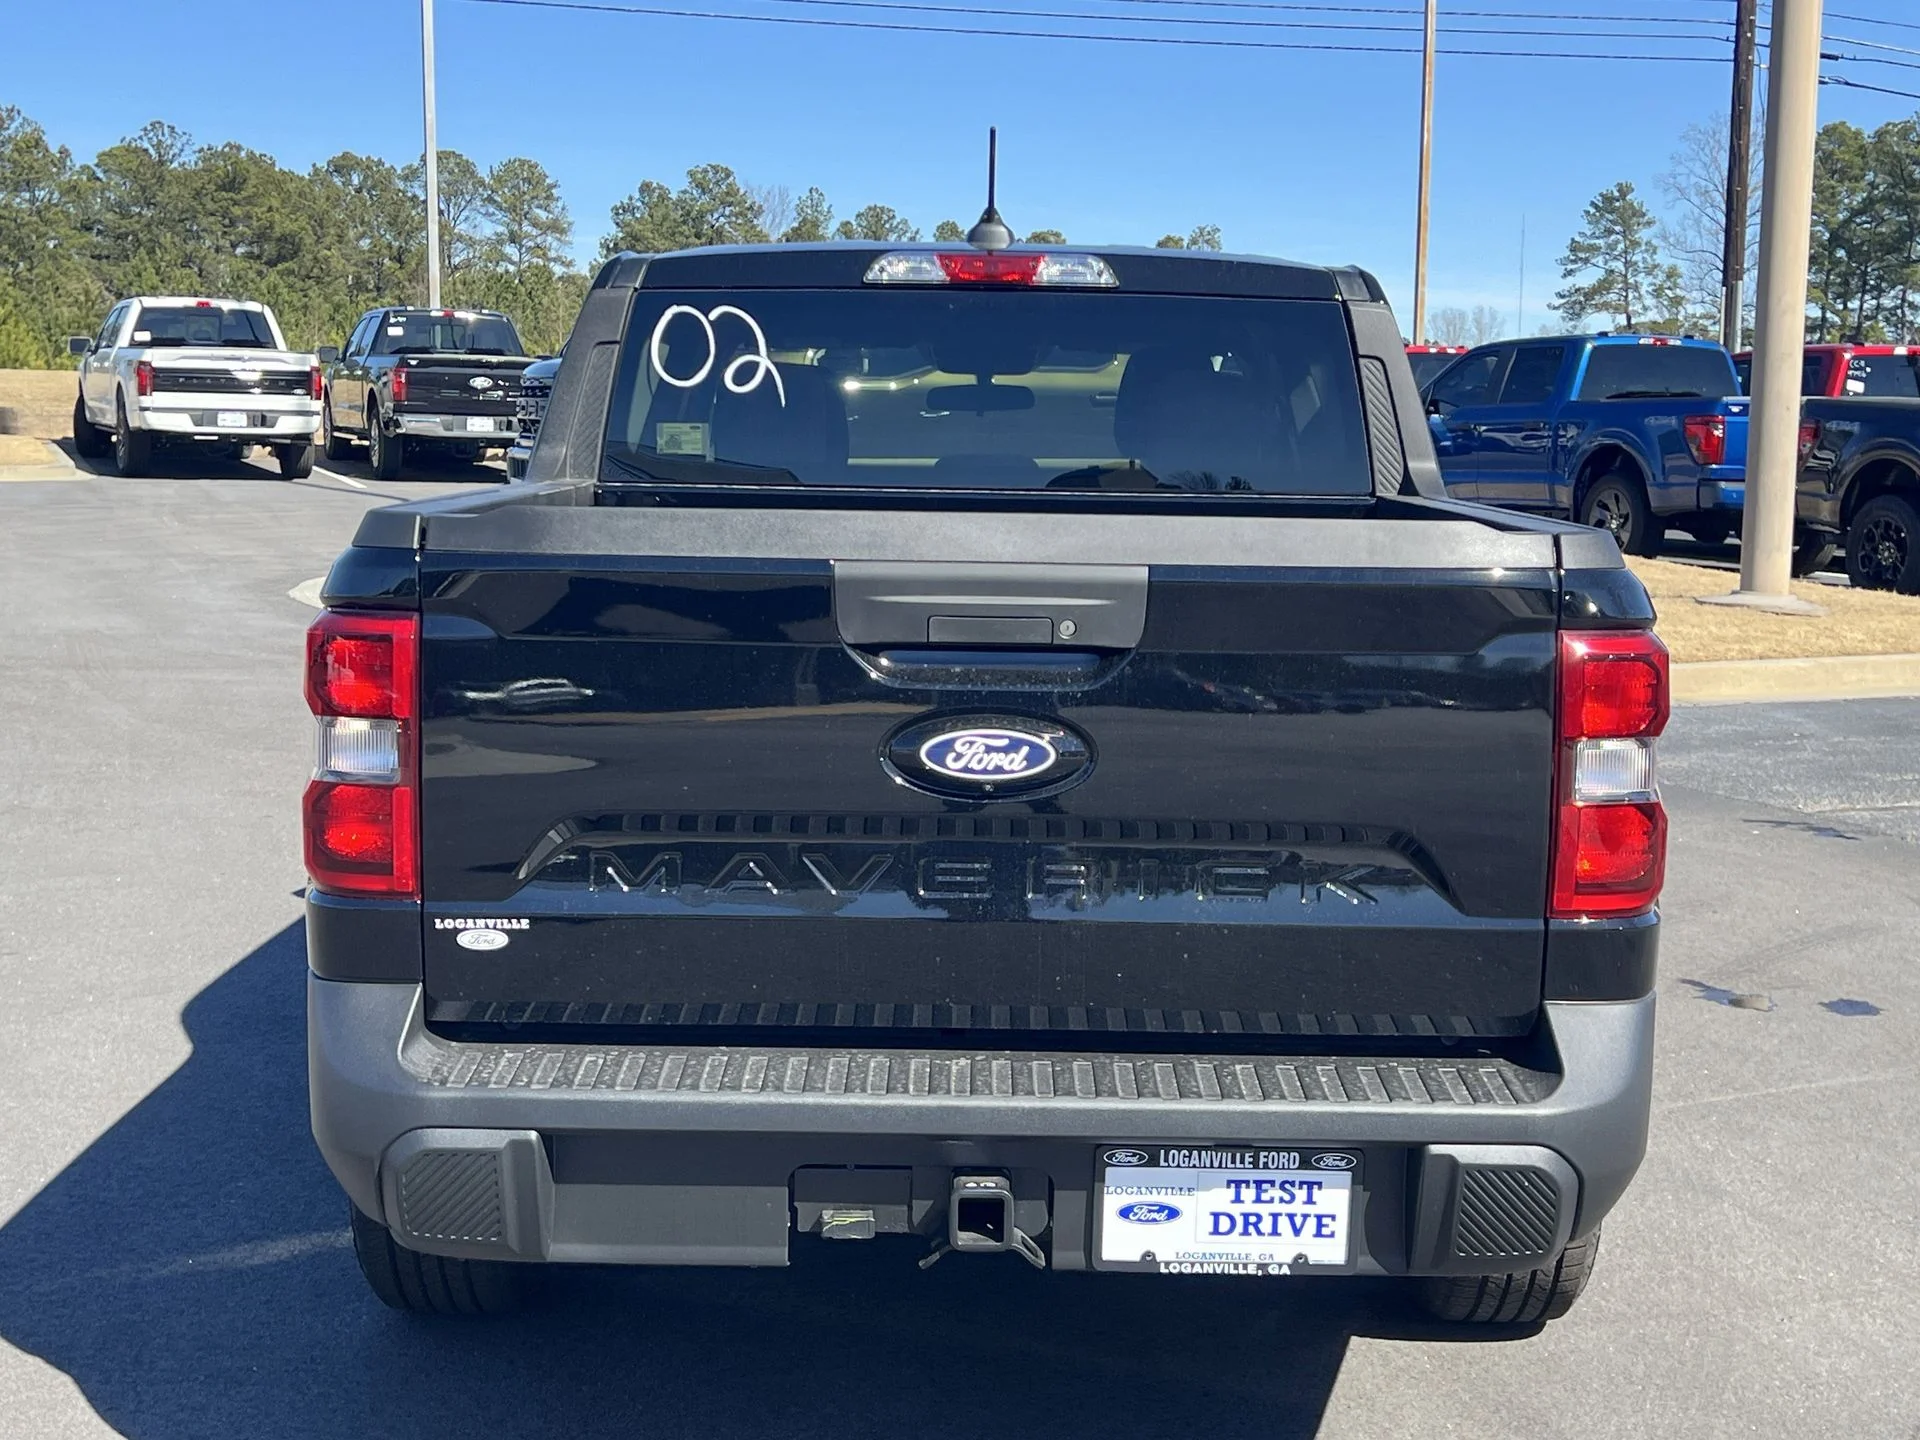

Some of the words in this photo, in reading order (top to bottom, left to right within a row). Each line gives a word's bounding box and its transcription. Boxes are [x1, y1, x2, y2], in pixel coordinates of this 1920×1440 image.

[590, 851, 1379, 904] MAVERICK
[434, 918, 530, 930] LOGANVILLE
[1160, 1150, 1254, 1169] LOGANVILLE
[1258, 1151, 1301, 1170] FORD
[1103, 1185, 1196, 1197] LOGANVILLE
[1225, 1179, 1323, 1206] TEST
[1208, 1210, 1337, 1239] DRIVE
[1174, 1250, 1256, 1262] LOGANVILLE,
[1258, 1252, 1275, 1262] GA
[1159, 1262, 1262, 1276] LOGANVILLE,
[1267, 1263, 1291, 1276] GA
